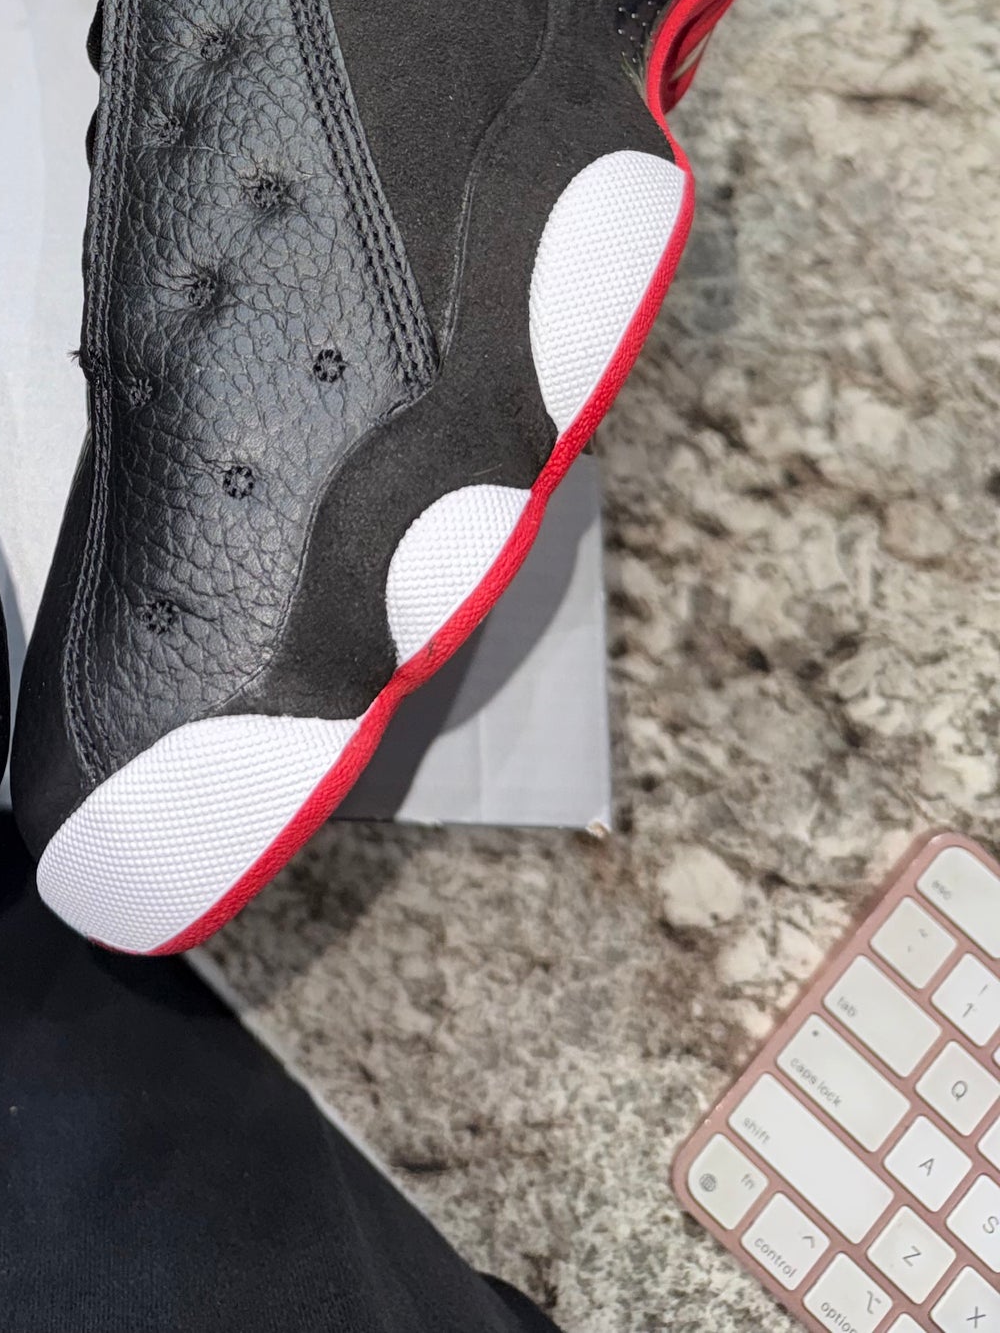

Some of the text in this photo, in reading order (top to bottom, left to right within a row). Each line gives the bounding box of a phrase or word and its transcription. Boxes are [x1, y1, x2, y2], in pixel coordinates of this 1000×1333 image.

[836, 996, 858, 1019] tab
[962, 1001, 974, 1018] 1
[790, 1057, 843, 1108] caps lock
[951, 1080, 969, 1102] Q
[742, 1116, 772, 1145] shift
[918, 1157, 935, 1177] A
[740, 1172, 756, 1191] fn
[982, 1216, 1000, 1234] S
[753, 1237, 798, 1279] control
[902, 1245, 922, 1268] Z
[966, 1305, 987, 1329] X
